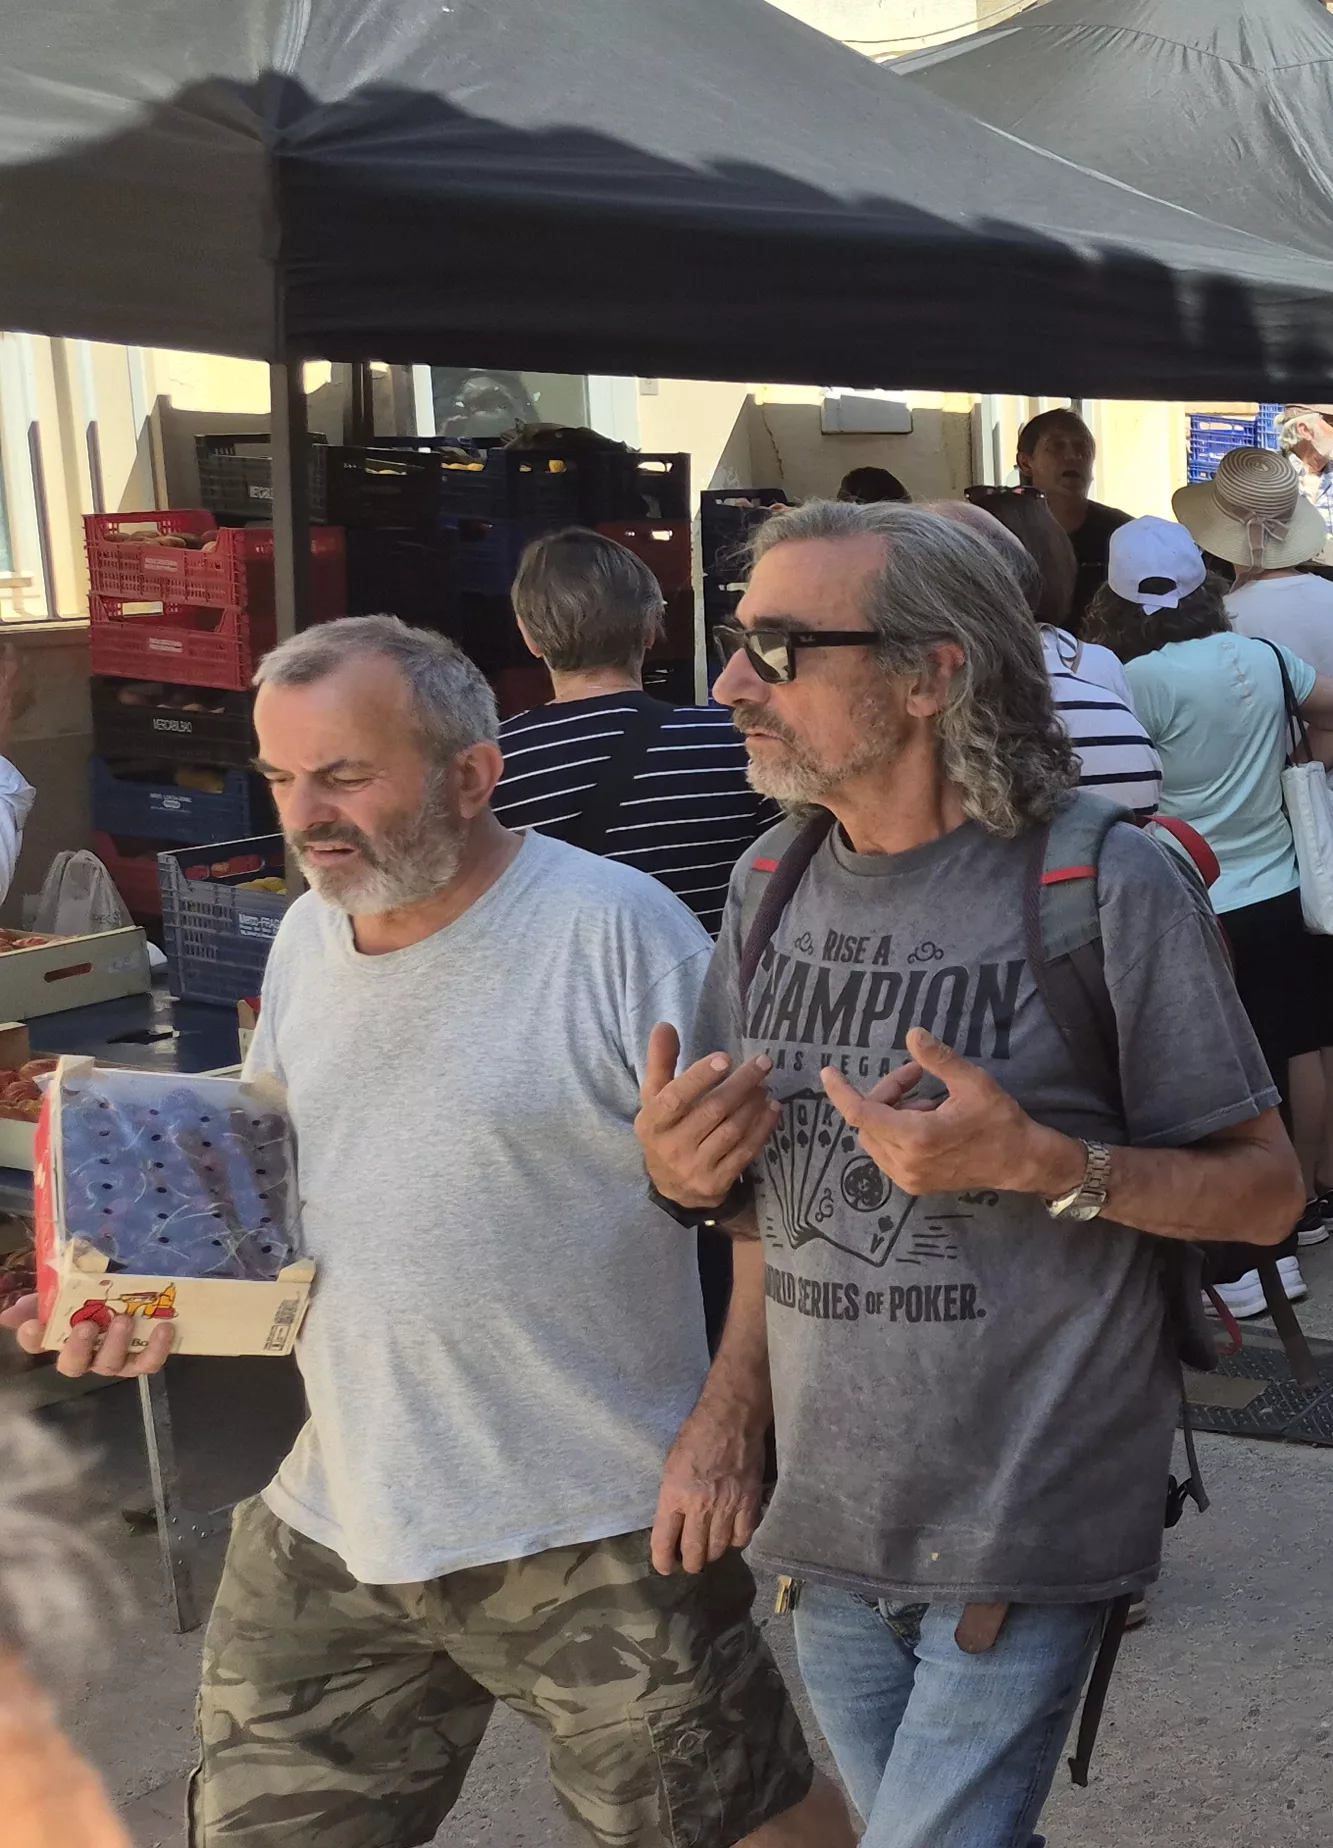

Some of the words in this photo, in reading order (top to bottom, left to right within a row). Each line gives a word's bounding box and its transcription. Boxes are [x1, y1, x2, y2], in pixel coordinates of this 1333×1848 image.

[821, 928, 871, 965] RISE
[872, 934, 893, 966] A
[744, 950, 1027, 1060] HAMPION
[765, 1262, 796, 1309] ORLD
[797, 1276, 860, 1322] SERIES
